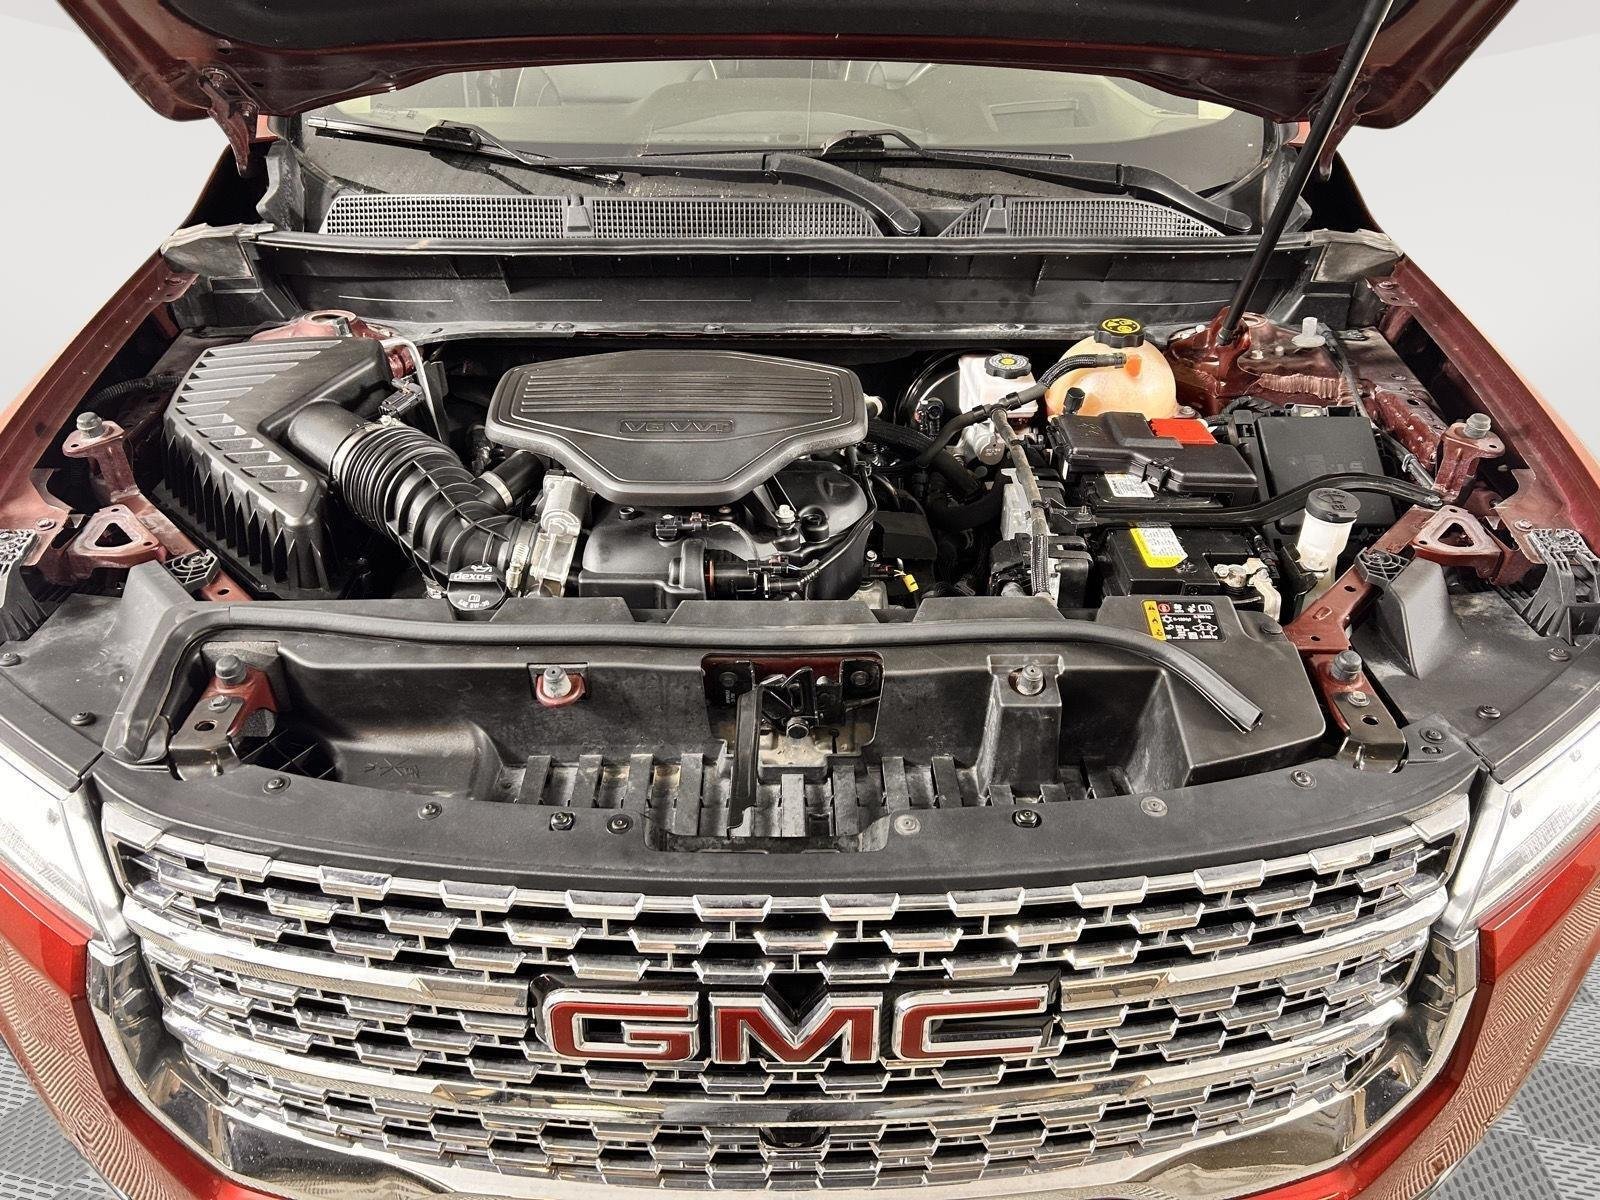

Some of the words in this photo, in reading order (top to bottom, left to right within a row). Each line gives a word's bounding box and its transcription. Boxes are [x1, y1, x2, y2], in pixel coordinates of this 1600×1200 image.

[624, 421, 664, 432] V6
[453, 572, 493, 581] dexos
[542, 987, 1049, 1062] GMC
